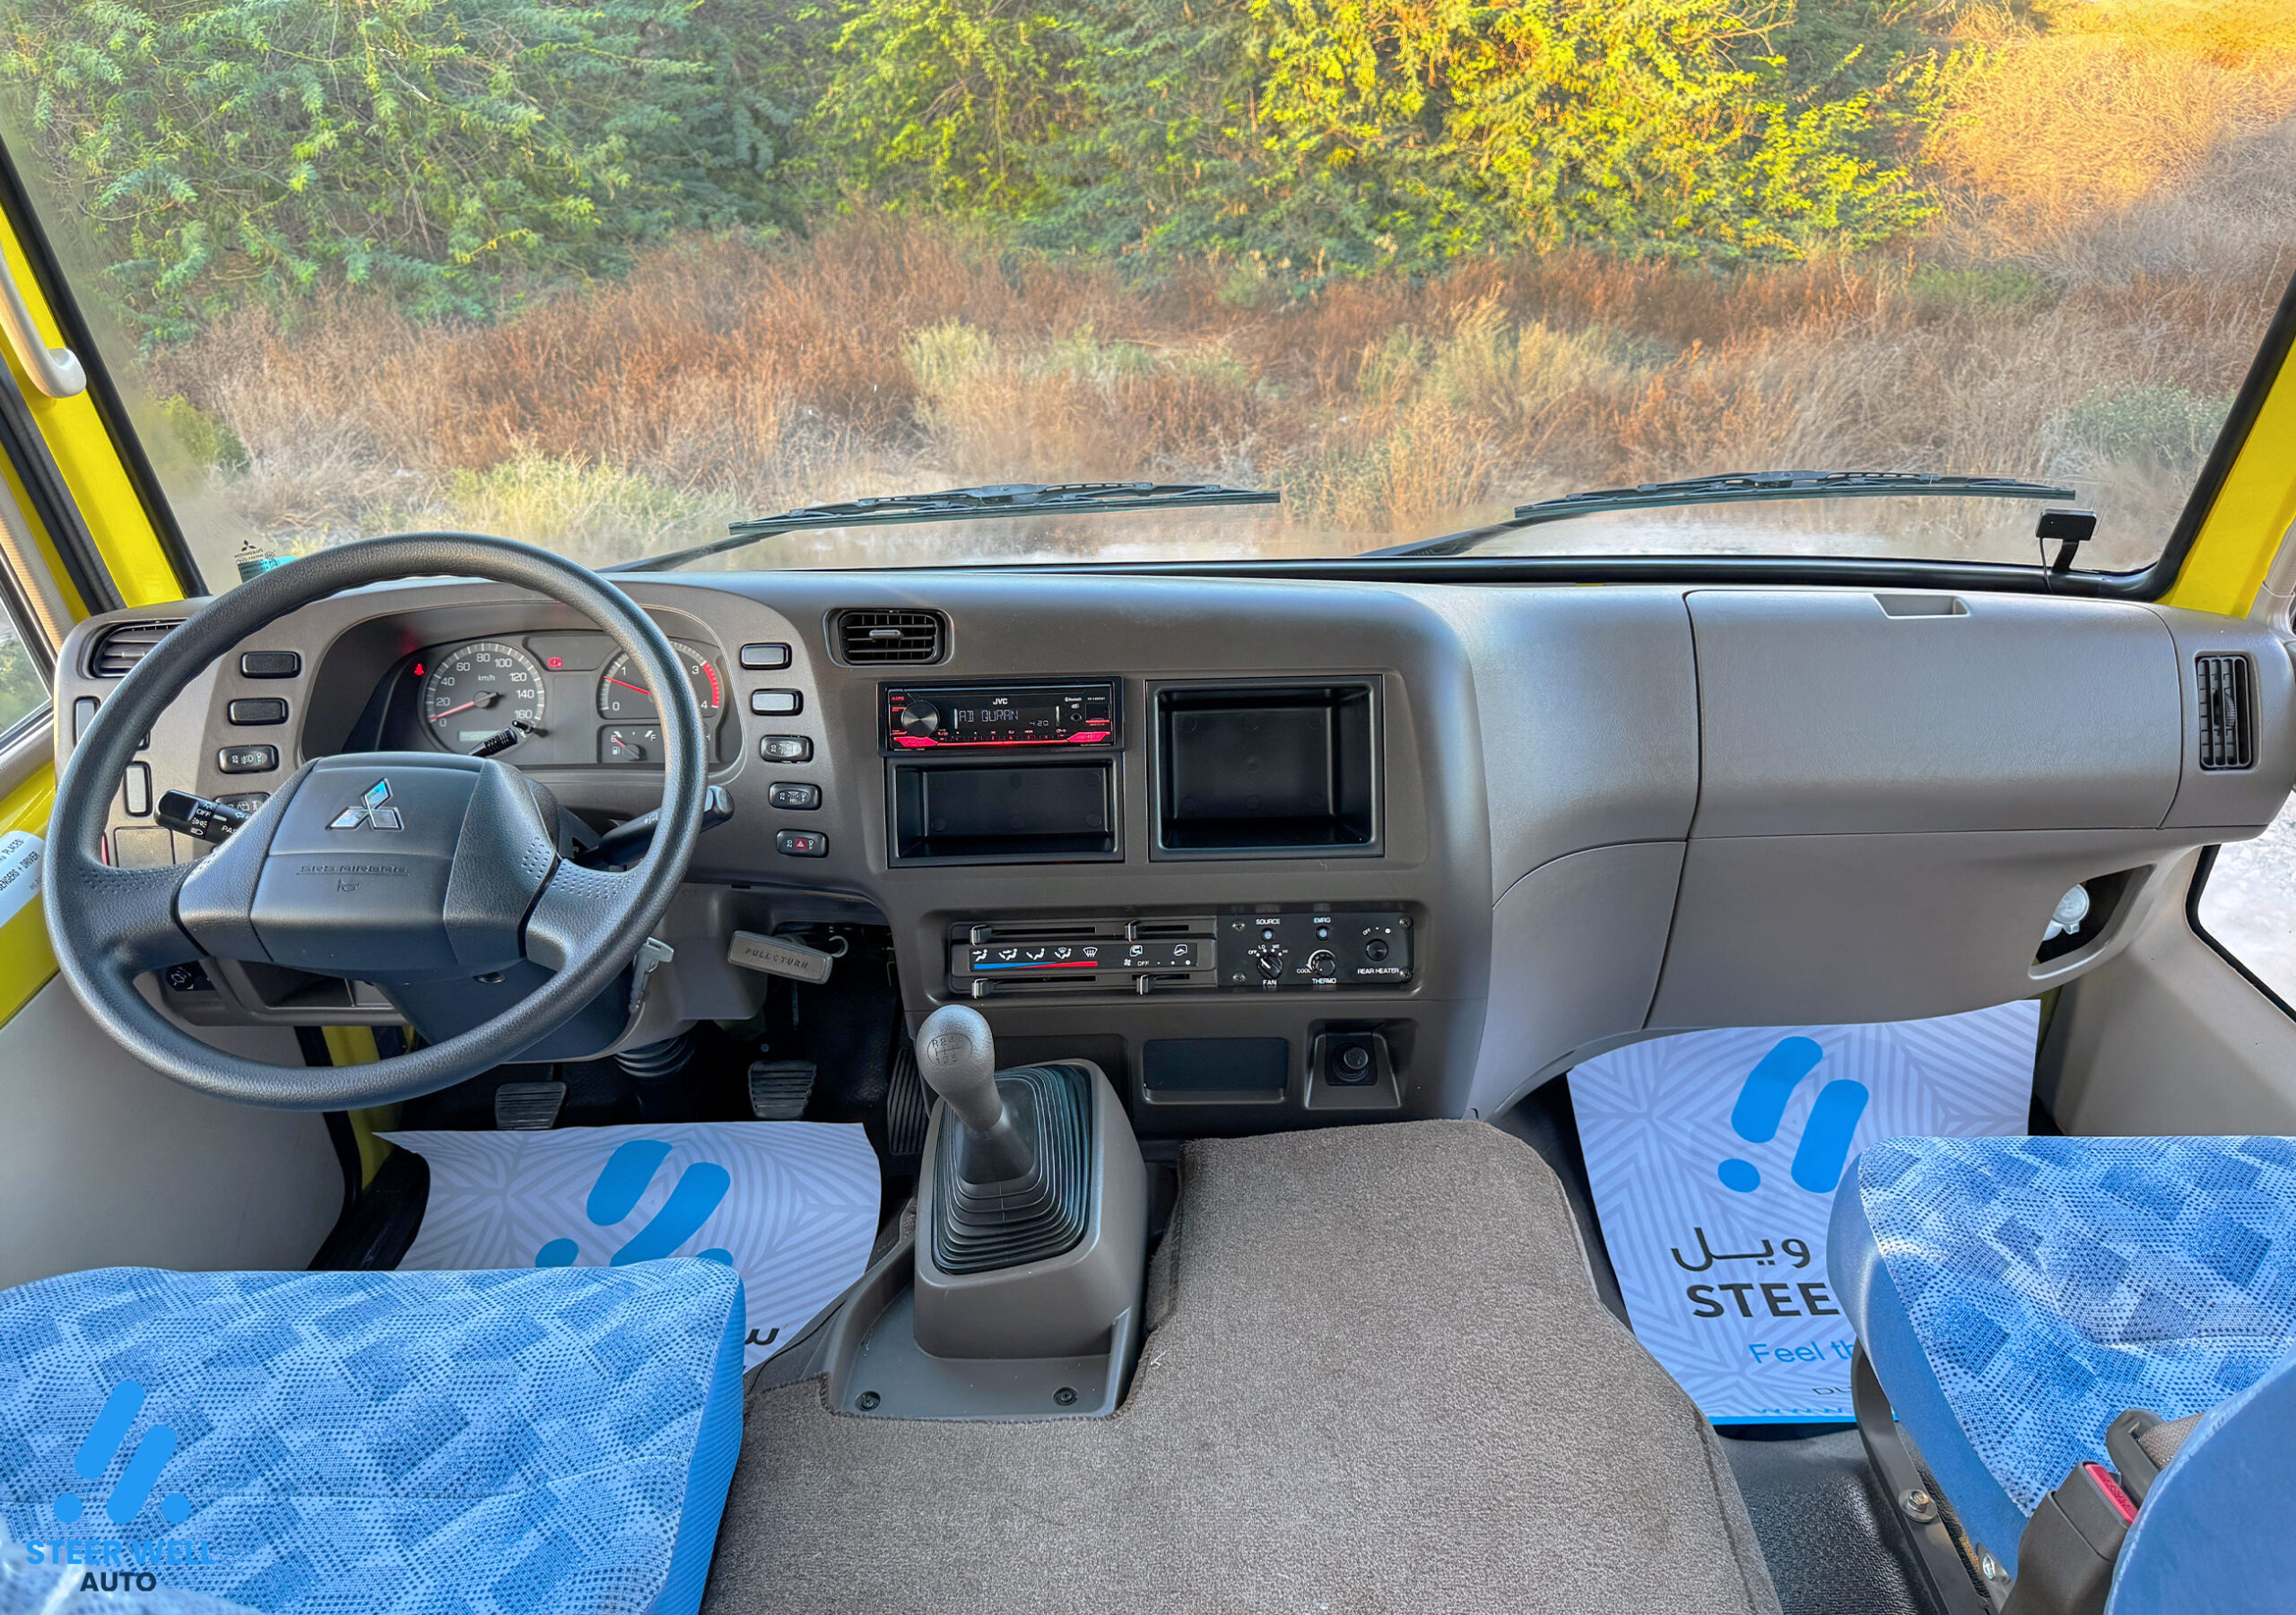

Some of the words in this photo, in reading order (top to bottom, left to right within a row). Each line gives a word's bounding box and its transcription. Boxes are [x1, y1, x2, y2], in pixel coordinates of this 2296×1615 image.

[476, 653, 491, 663] 80
[494, 658, 512, 668] 100
[457, 662, 470, 672] 60
[620, 666, 626, 675] 1
[691, 665, 700, 674] 3
[440, 676, 455, 686] 40
[509, 672, 527, 682] 120
[517, 689, 535, 699] 140
[436, 697, 450, 707] 20
[612, 701, 620, 711] 0
[700, 700, 709, 709] 4
[514, 709, 533, 719] 160
[981, 709, 1019, 723] QURAN
[439, 718, 448, 727] 0
[196, 808, 212, 817] OFF
[745, 948, 770, 959] PULL
[779, 955, 808, 968] TURN
[1375, 967, 1400, 975] HEATER
[1671, 1227, 1811, 1272] ويل
[1686, 1282, 1840, 1318] STEE
[1749, 1341, 1826, 1364] Feel
